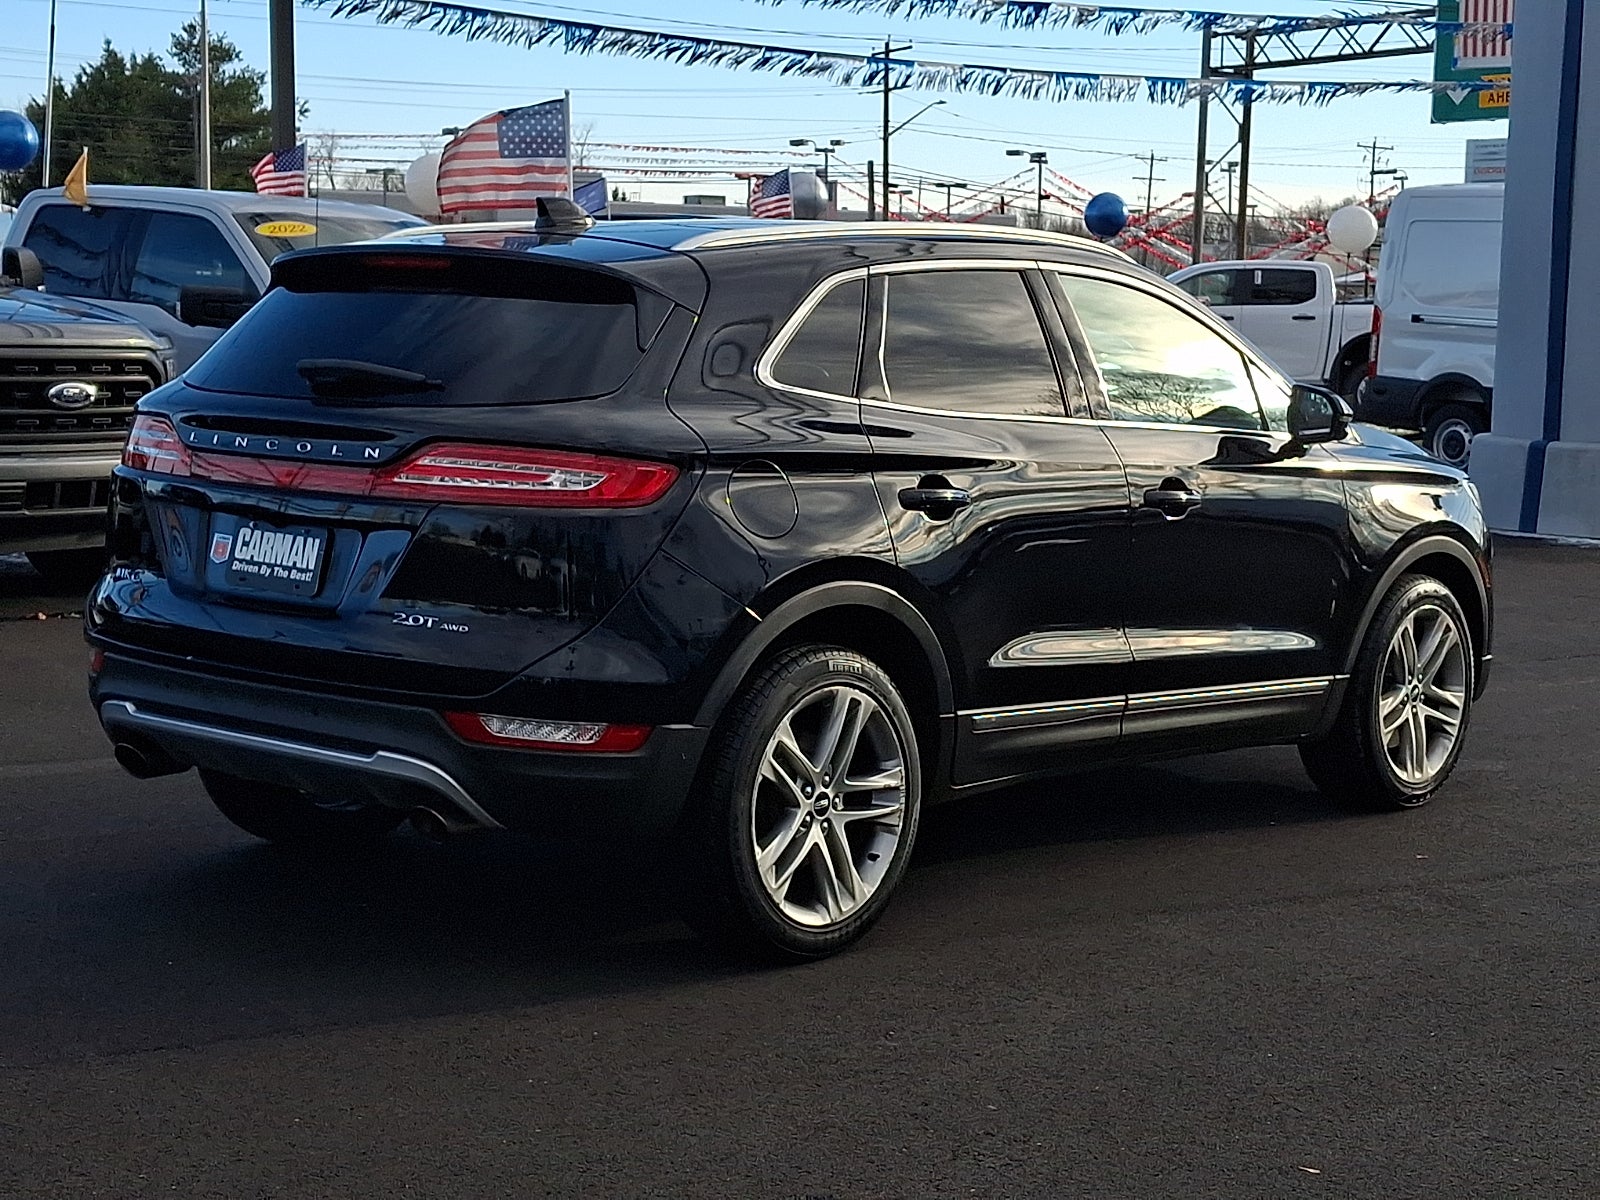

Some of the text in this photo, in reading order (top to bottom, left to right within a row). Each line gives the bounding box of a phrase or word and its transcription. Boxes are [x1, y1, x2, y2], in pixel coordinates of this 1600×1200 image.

[268, 224, 308, 234] 2022
[189, 431, 380, 459] LINCOLN
[234, 527, 321, 570] CARMAN
[231, 560, 314, 582] Driven By The Best!
[439, 623, 469, 632] AWD
[828, 660, 862, 674] PIRELLI
